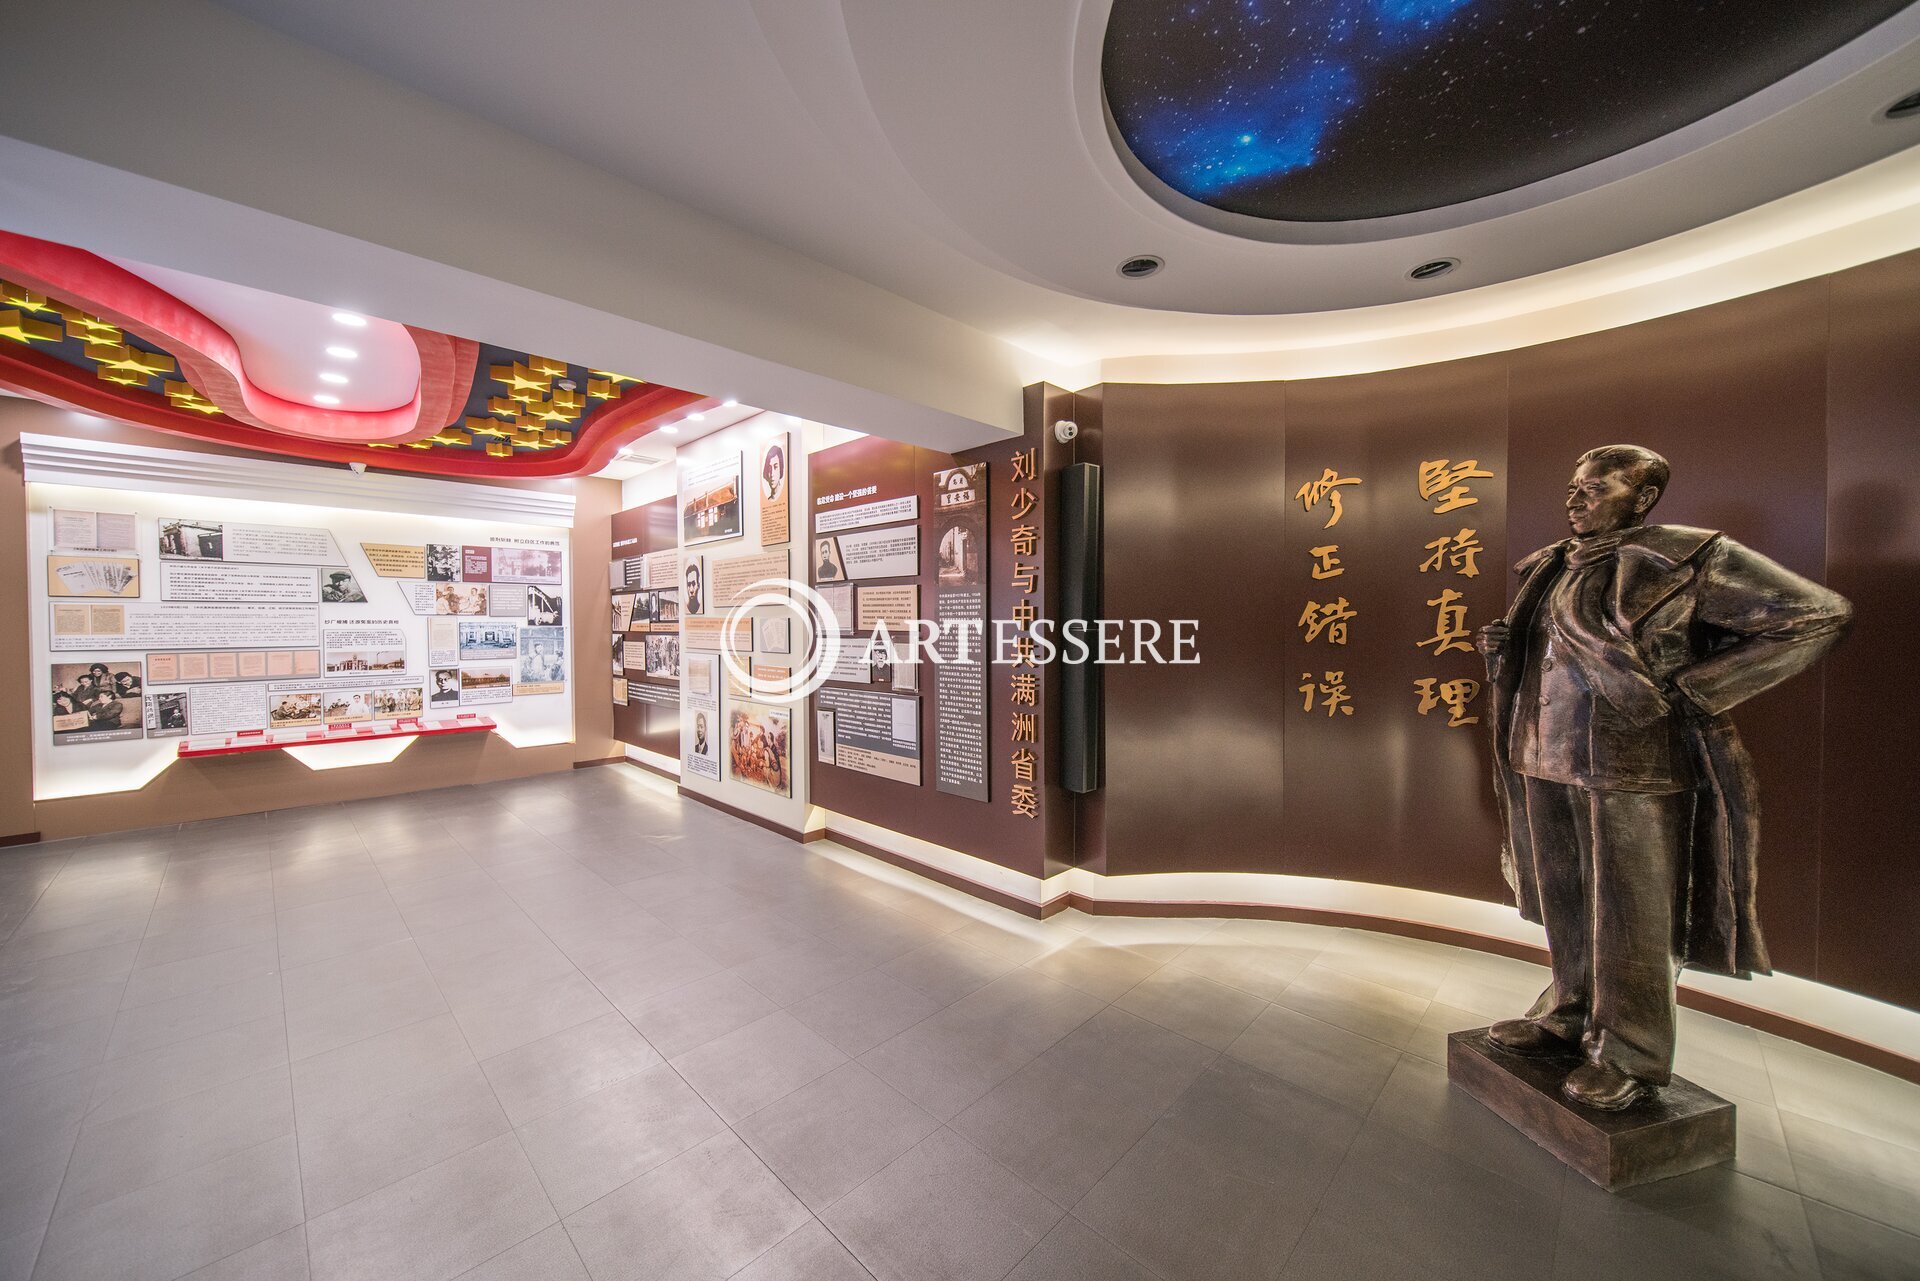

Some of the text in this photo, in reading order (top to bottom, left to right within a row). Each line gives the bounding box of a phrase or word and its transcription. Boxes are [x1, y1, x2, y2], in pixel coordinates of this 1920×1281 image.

[1010, 447, 1041, 820] 刘少奇与中共满洲省委
